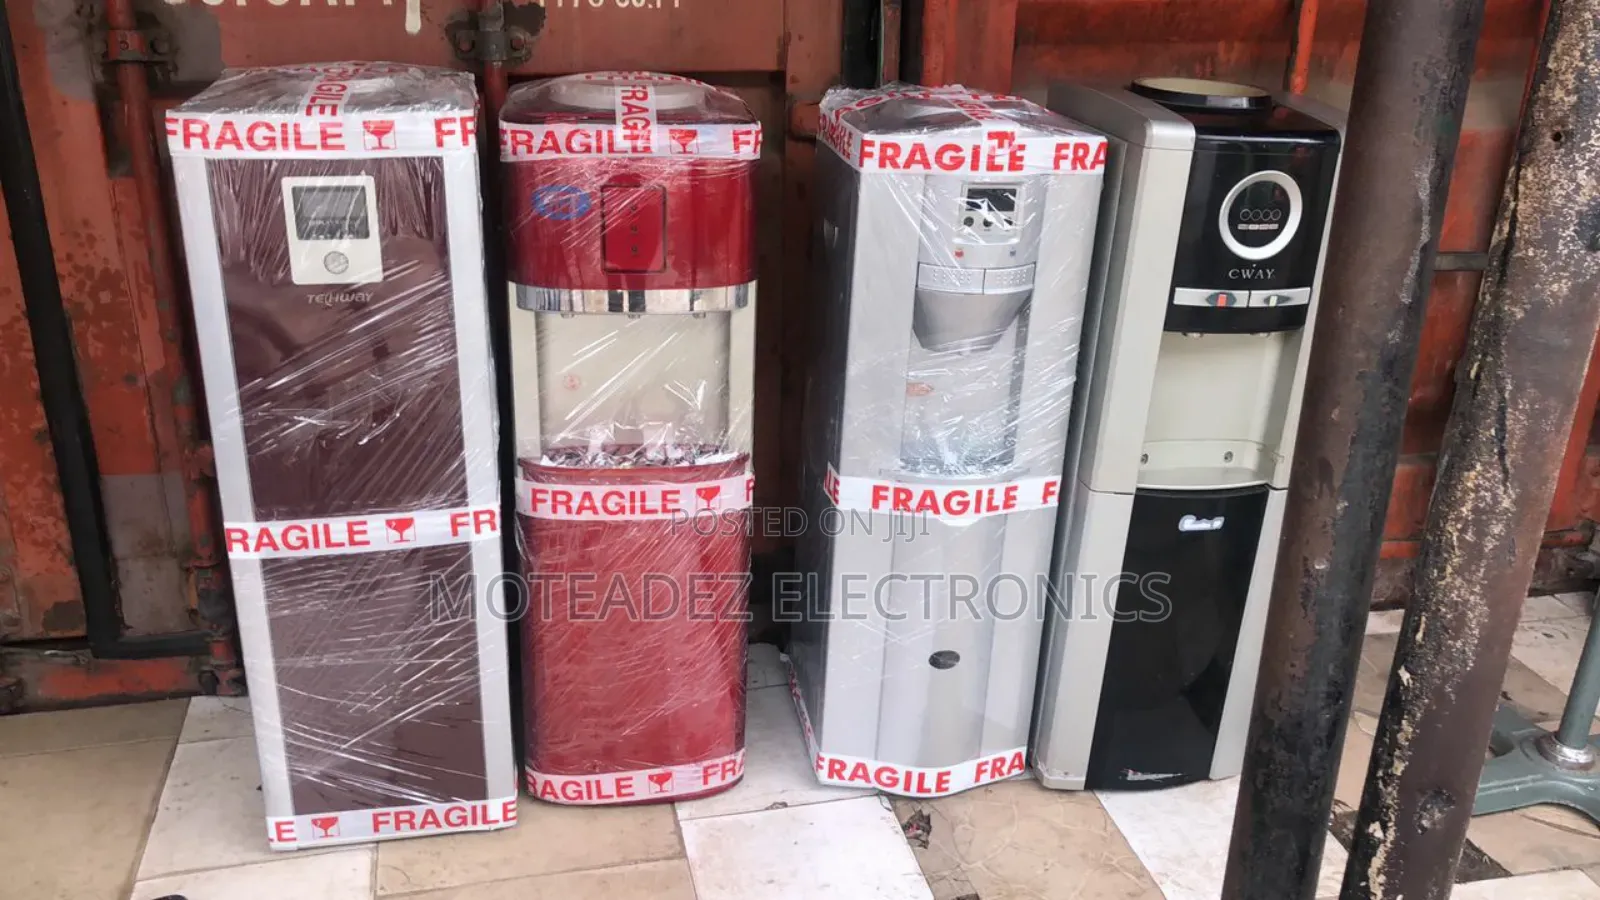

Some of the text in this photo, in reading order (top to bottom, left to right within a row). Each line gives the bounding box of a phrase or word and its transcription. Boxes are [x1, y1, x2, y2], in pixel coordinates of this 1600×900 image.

[859, 139, 1026, 172] FRAGILE
[1228, 268, 1275, 280] CWAY
[531, 487, 681, 516] FRAGILE
[871, 484, 1019, 516] FRAGILE
[226, 509, 497, 552] RAGILE FR
[975, 751, 1025, 783] FRA
[373, 800, 518, 833] FRAGILE
